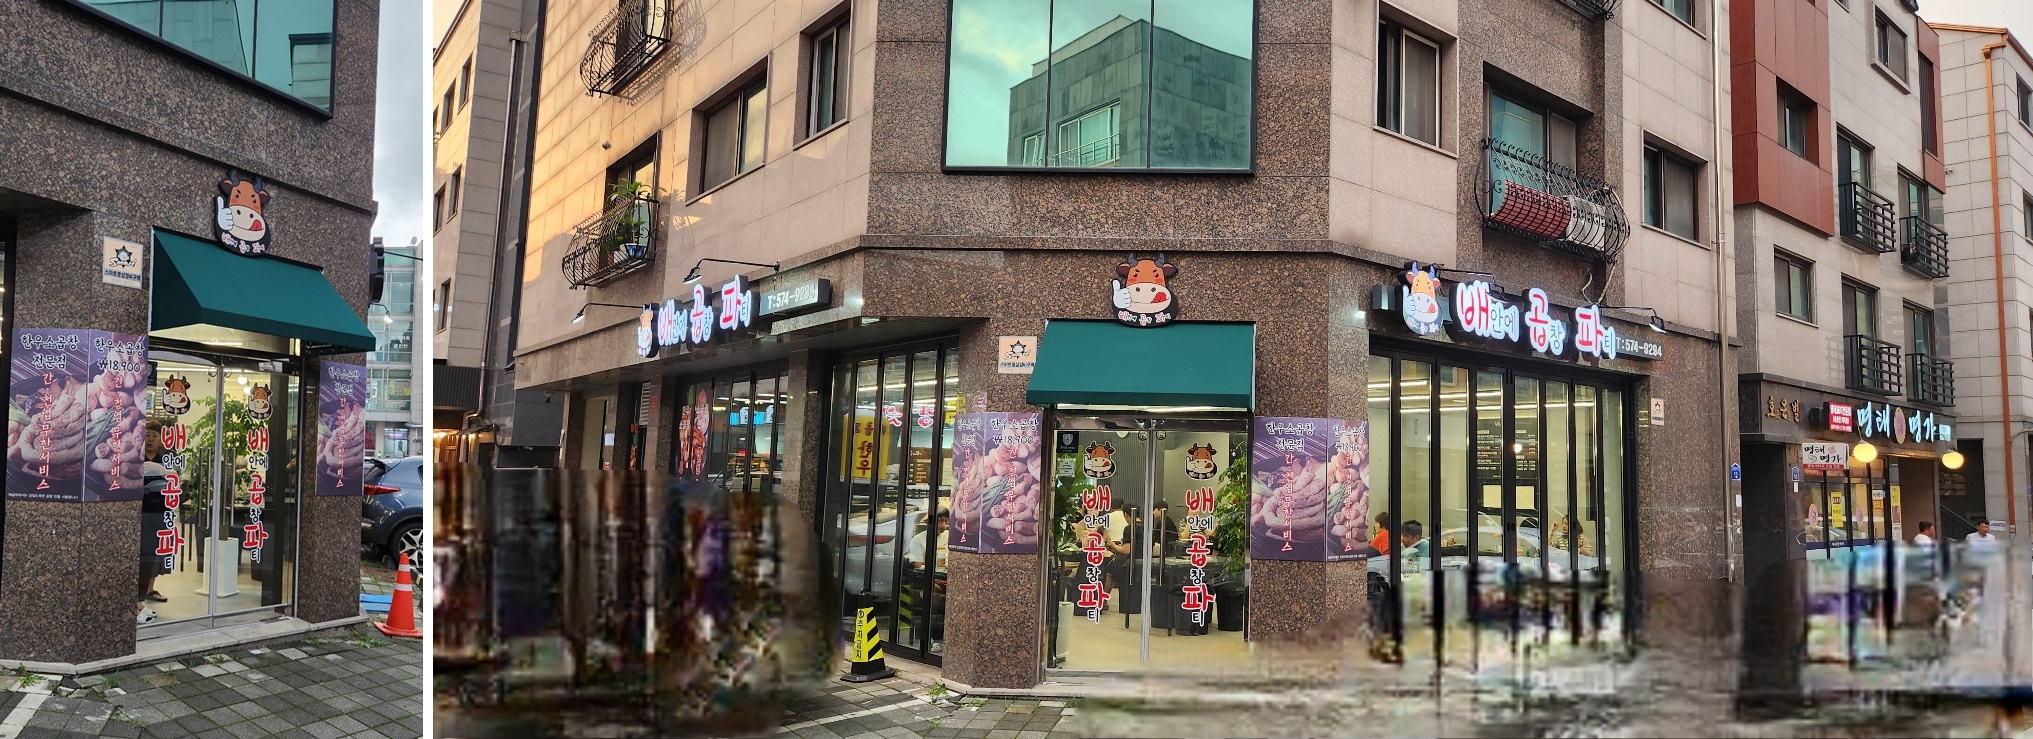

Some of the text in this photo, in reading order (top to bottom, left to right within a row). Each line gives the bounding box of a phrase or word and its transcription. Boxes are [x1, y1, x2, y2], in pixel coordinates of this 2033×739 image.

[657, 275, 751, 346] 배안에 곱창 파티
[1456, 280, 1616, 360] 배안에 곱창 파티
[20, 333, 79, 350] 한우소곱창
[32, 354, 67, 369] 전문점
[94, 338, 145, 357] 한우소곱창
[1615, 336, 1662, 358] T:574-9294
[990, 418, 1039, 431] 한우소곱창
[1265, 421, 1315, 436] 한우소곱창
[1857, 400, 1890, 438] 명태
[1908, 410, 1937, 443] 명가
[160, 422, 187, 470] 배안에
[247, 427, 270, 470] 배안에
[1275, 438, 1305, 451] 전문점
[1804, 445, 1825, 454] 명태
[1820, 454, 1842, 463] 명가
[161, 473, 182, 528] 곱창
[247, 473, 265, 522] 곱창
[1082, 485, 1112, 529] 배안에
[1186, 487, 1215, 531] 배안에
[155, 526, 185, 571] 파티
[243, 521, 268, 563] 파티
[1083, 532, 1106, 583] 곱창
[1186, 533, 1209, 585] 곱창
[1077, 581, 1111, 625] 파티
[1182, 583, 1216, 627] 파티
[855, 620, 863, 660] 주차금지
